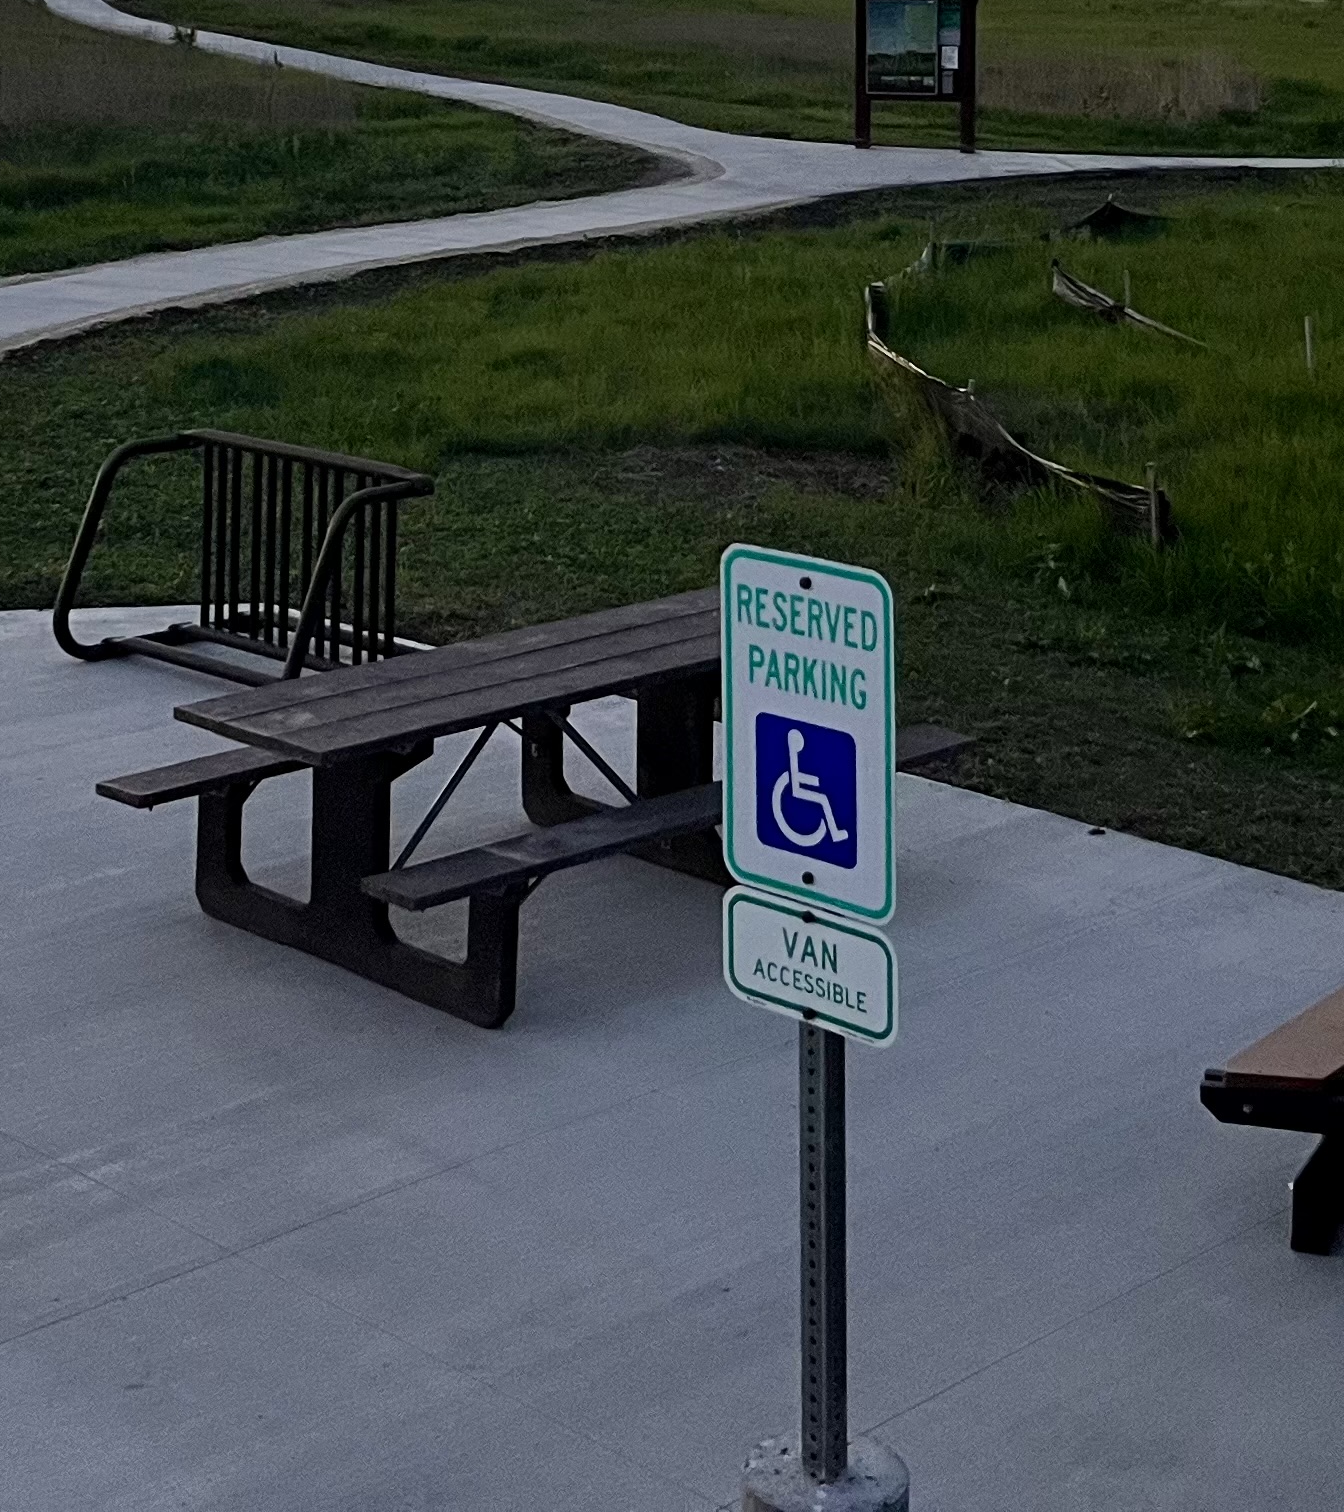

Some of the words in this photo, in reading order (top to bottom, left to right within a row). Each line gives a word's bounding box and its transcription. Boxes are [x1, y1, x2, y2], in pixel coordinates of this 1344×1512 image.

[736, 584, 878, 652] RESERVED
[748, 644, 867, 711] PARKING
[782, 927, 838, 974] VAN
[753, 958, 868, 1014] ACCESSIBLE
